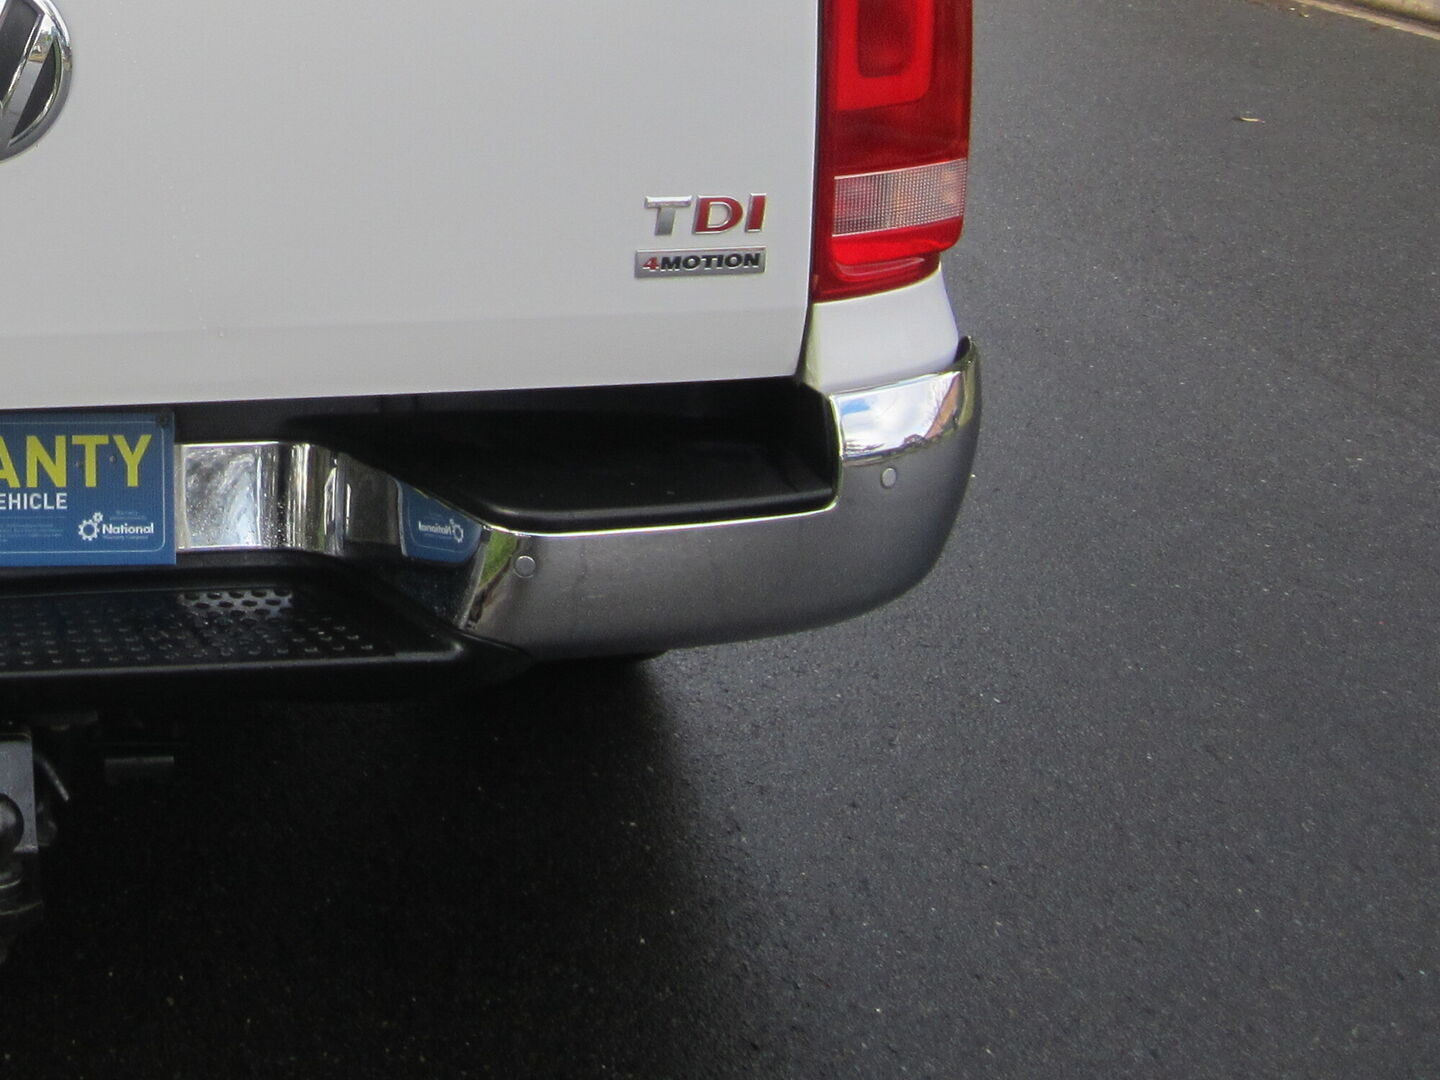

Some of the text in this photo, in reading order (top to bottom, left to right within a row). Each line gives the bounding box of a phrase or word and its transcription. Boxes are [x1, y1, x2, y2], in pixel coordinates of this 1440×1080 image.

[644, 192, 767, 236] TDI
[642, 252, 761, 272] 4MOTION
[102, 522, 154, 535] National
